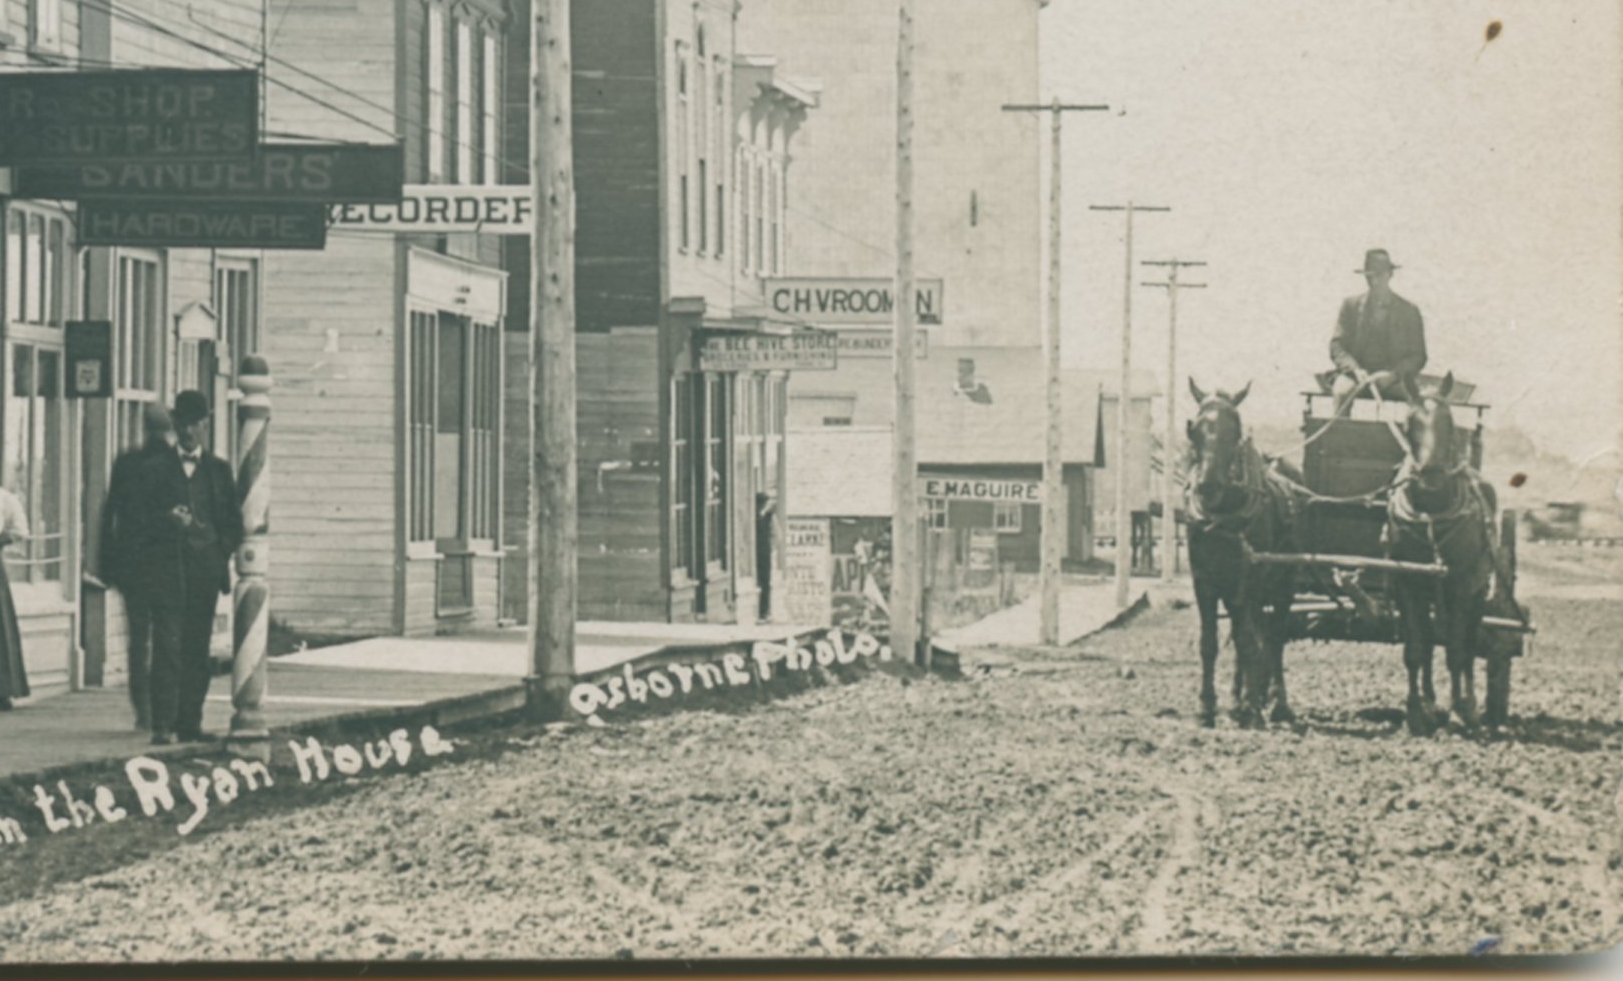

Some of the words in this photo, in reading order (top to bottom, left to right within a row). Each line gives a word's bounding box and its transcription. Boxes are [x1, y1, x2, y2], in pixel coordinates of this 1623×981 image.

[44, 122, 249, 155] SUPPLIES
[816, 288, 933, 315] VROOMN
[945, 481, 1039, 500] MAGUIRE
